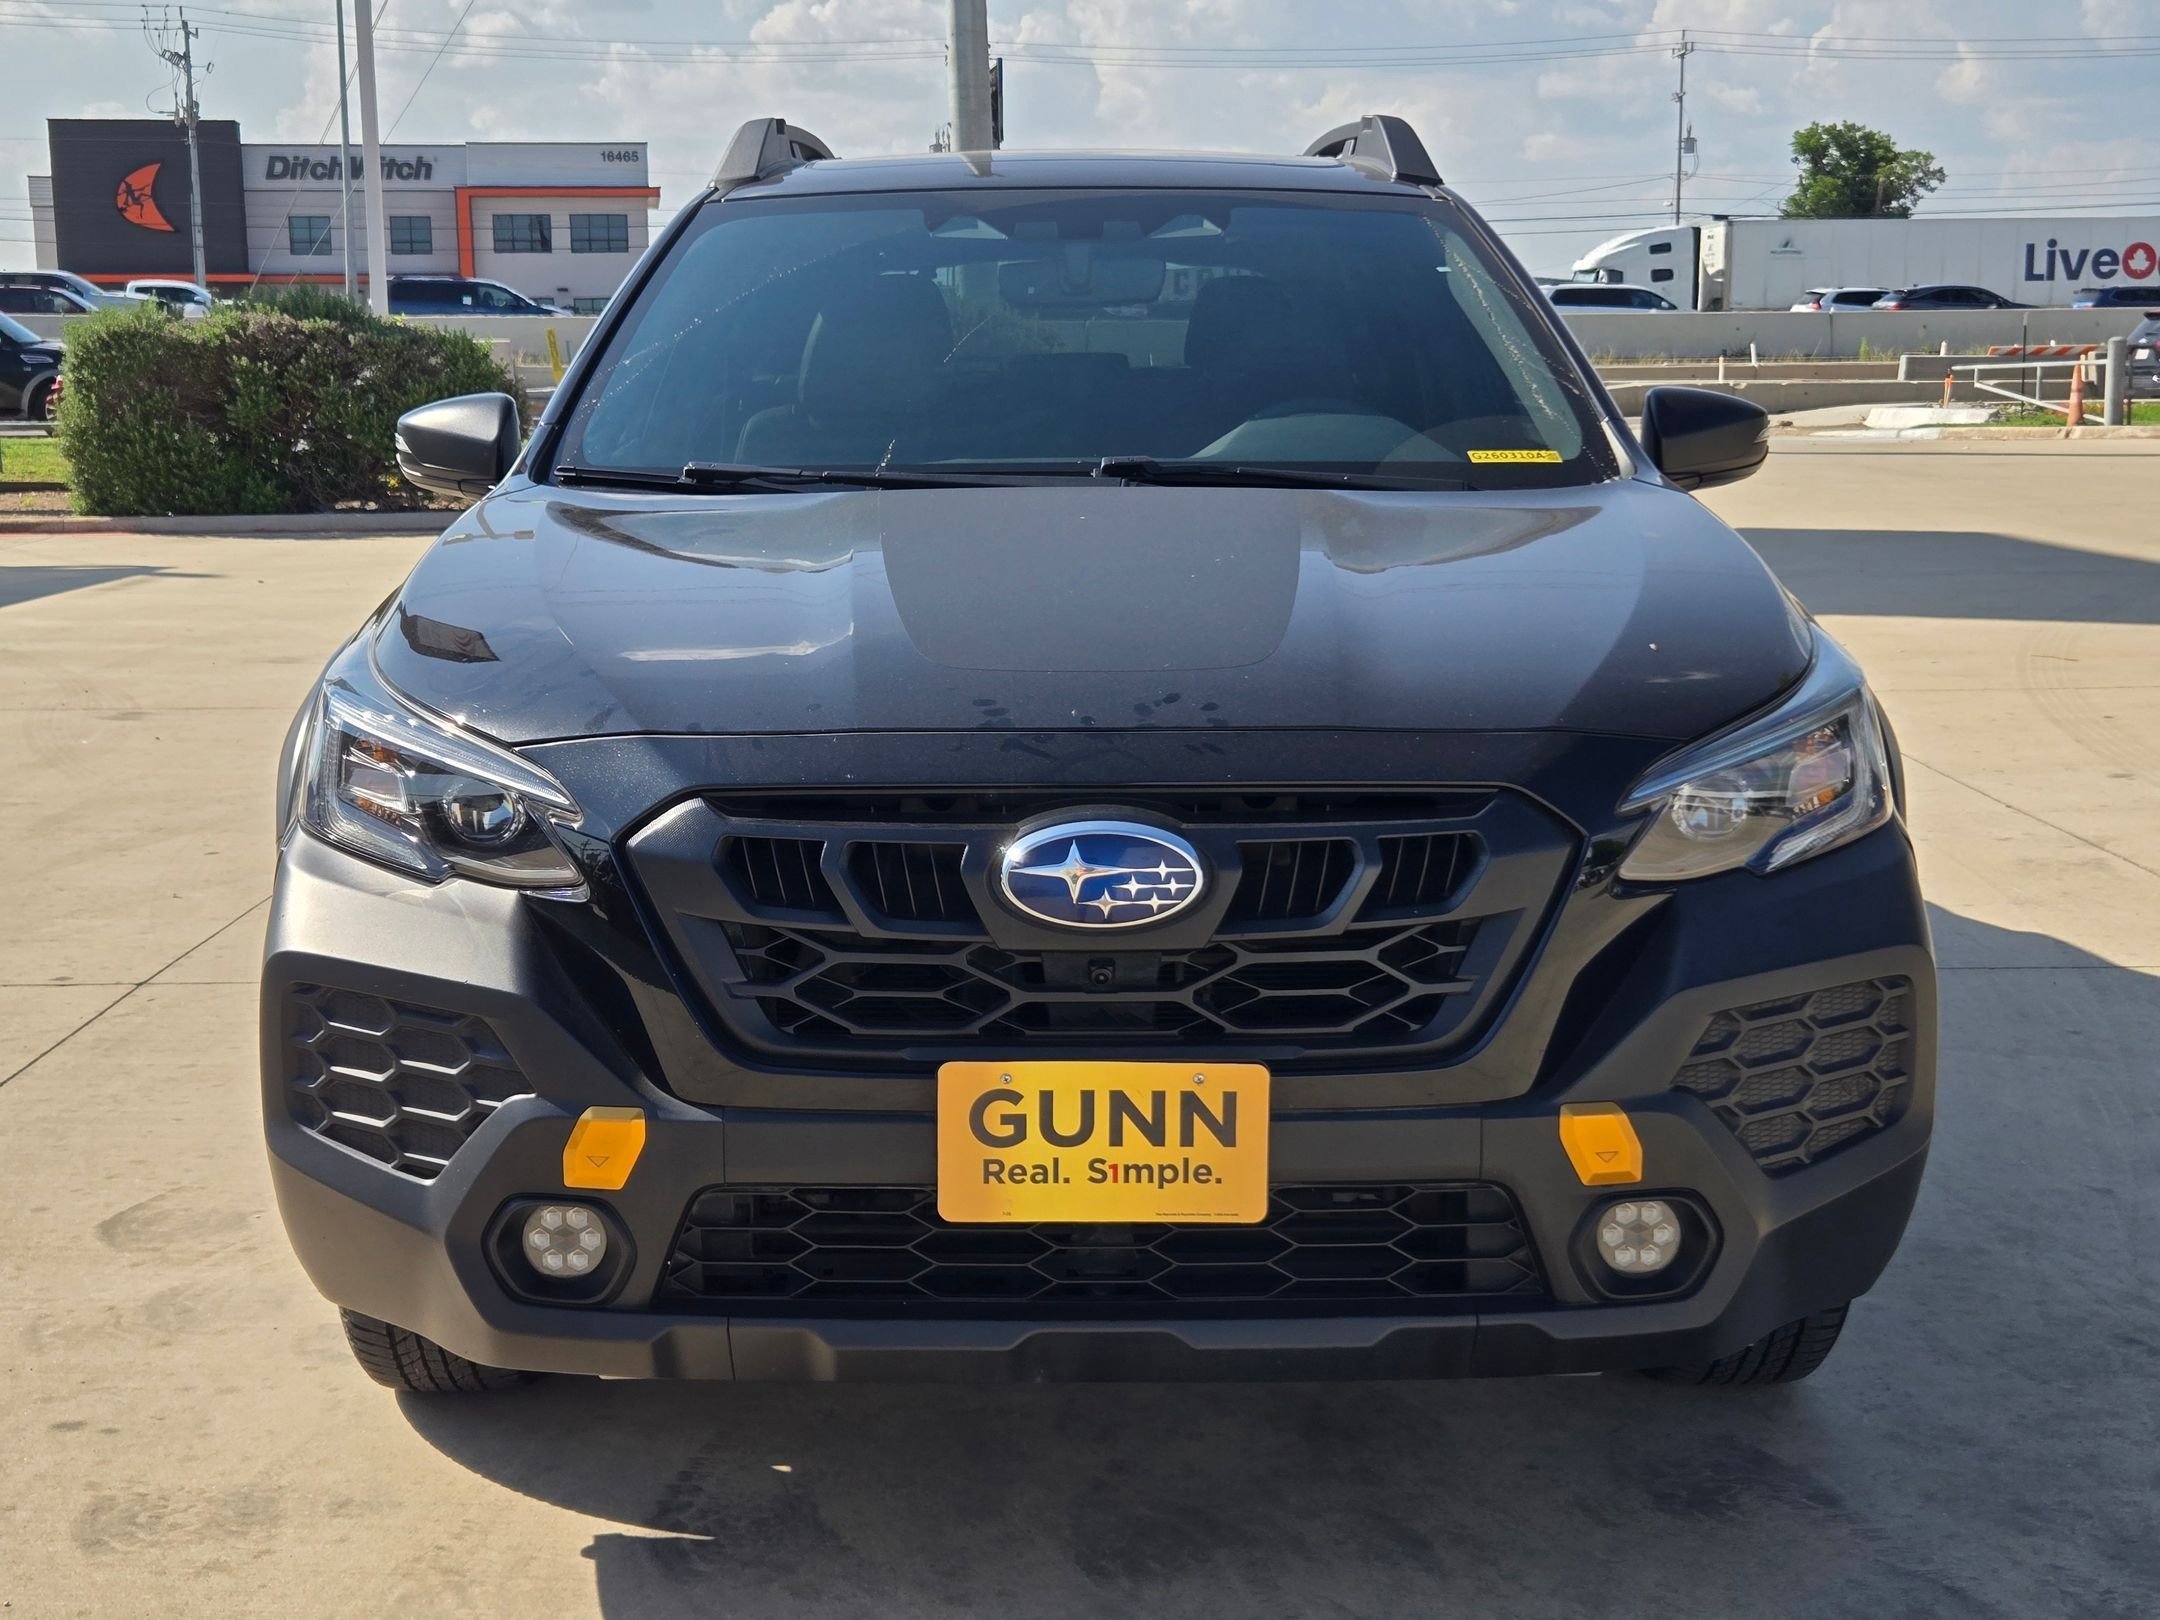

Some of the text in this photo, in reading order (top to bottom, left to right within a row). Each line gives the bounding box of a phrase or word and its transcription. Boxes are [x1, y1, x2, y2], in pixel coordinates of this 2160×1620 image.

[600, 150, 640, 163] 16465
[2024, 238, 2160, 281] LiveO
[968, 1088, 1238, 1148] GUNN
[983, 1157, 1071, 1185] Real.
